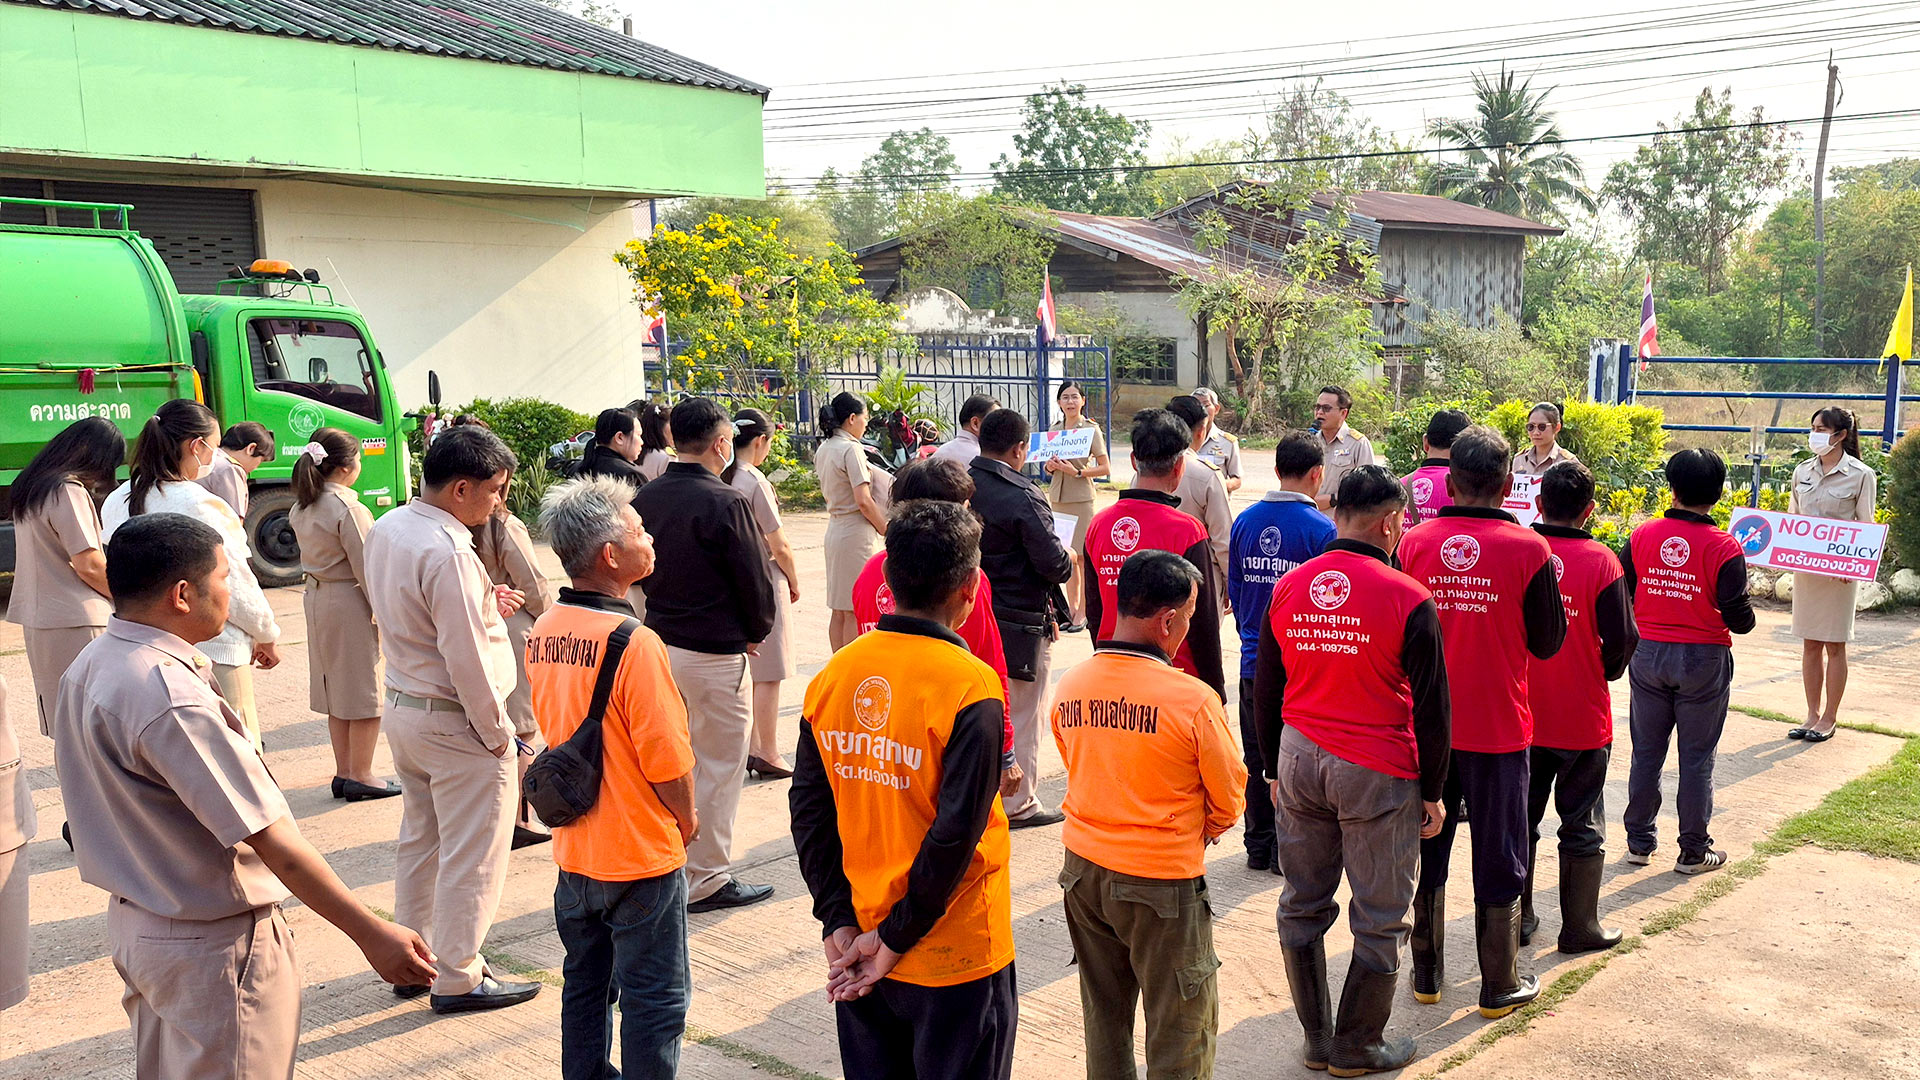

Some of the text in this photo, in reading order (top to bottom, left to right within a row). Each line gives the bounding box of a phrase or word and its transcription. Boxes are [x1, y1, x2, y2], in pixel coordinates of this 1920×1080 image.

[30, 403, 131, 421] ความสะอาด
[1513, 482, 1529, 491] IFT
[1778, 518, 1862, 544] NO GIFT
[1827, 543, 1878, 558] POLICY
[1777, 550, 1870, 575] งดรับของขวัญ
[1648, 567, 1696, 581] นายกสุเทพ
[1428, 576, 1491, 588] นายกสุเทพ
[1647, 587, 1693, 601] 044-109756
[1437, 602, 1488, 613] 44-109756
[1292, 613, 1361, 627] นายกสุเทพ
[1286, 628, 1370, 643] อบต.หนองขาม
[1296, 642, 1358, 655] 044-109756
